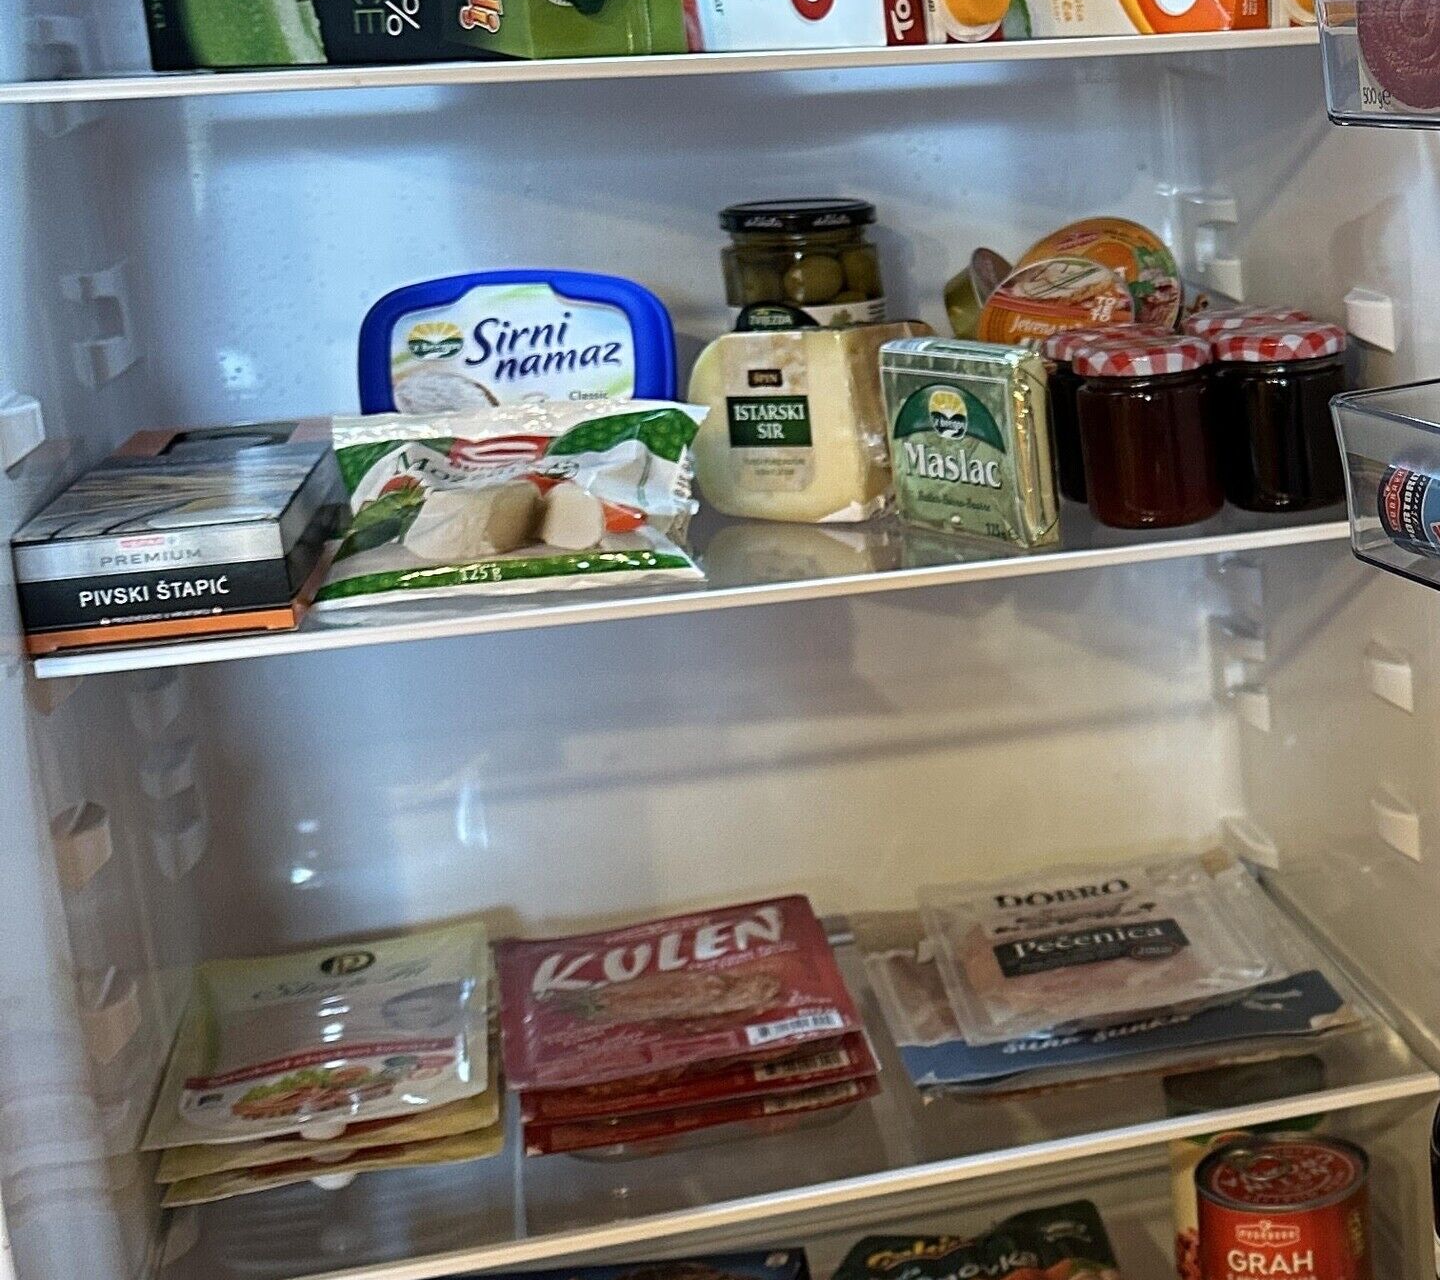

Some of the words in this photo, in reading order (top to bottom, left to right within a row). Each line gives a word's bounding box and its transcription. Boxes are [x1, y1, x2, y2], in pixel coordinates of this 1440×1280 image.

[465, 311, 572, 366] Sirni
[494, 342, 623, 382] namaz
[734, 403, 805, 421] ISTARSKI
[757, 422, 785, 439] SIR
[903, 441, 1001, 489] Maslac
[100, 547, 201, 569] PREMIUM
[78, 585, 149, 608] PIVSKI
[156, 575, 231, 601] ŠTAPIĆ
[992, 878, 1131, 910] DOBRO
[531, 905, 783, 1001] KULEN
[1013, 921, 1165, 959] Pečenica
[1226, 1249, 1315, 1276] GRAH
